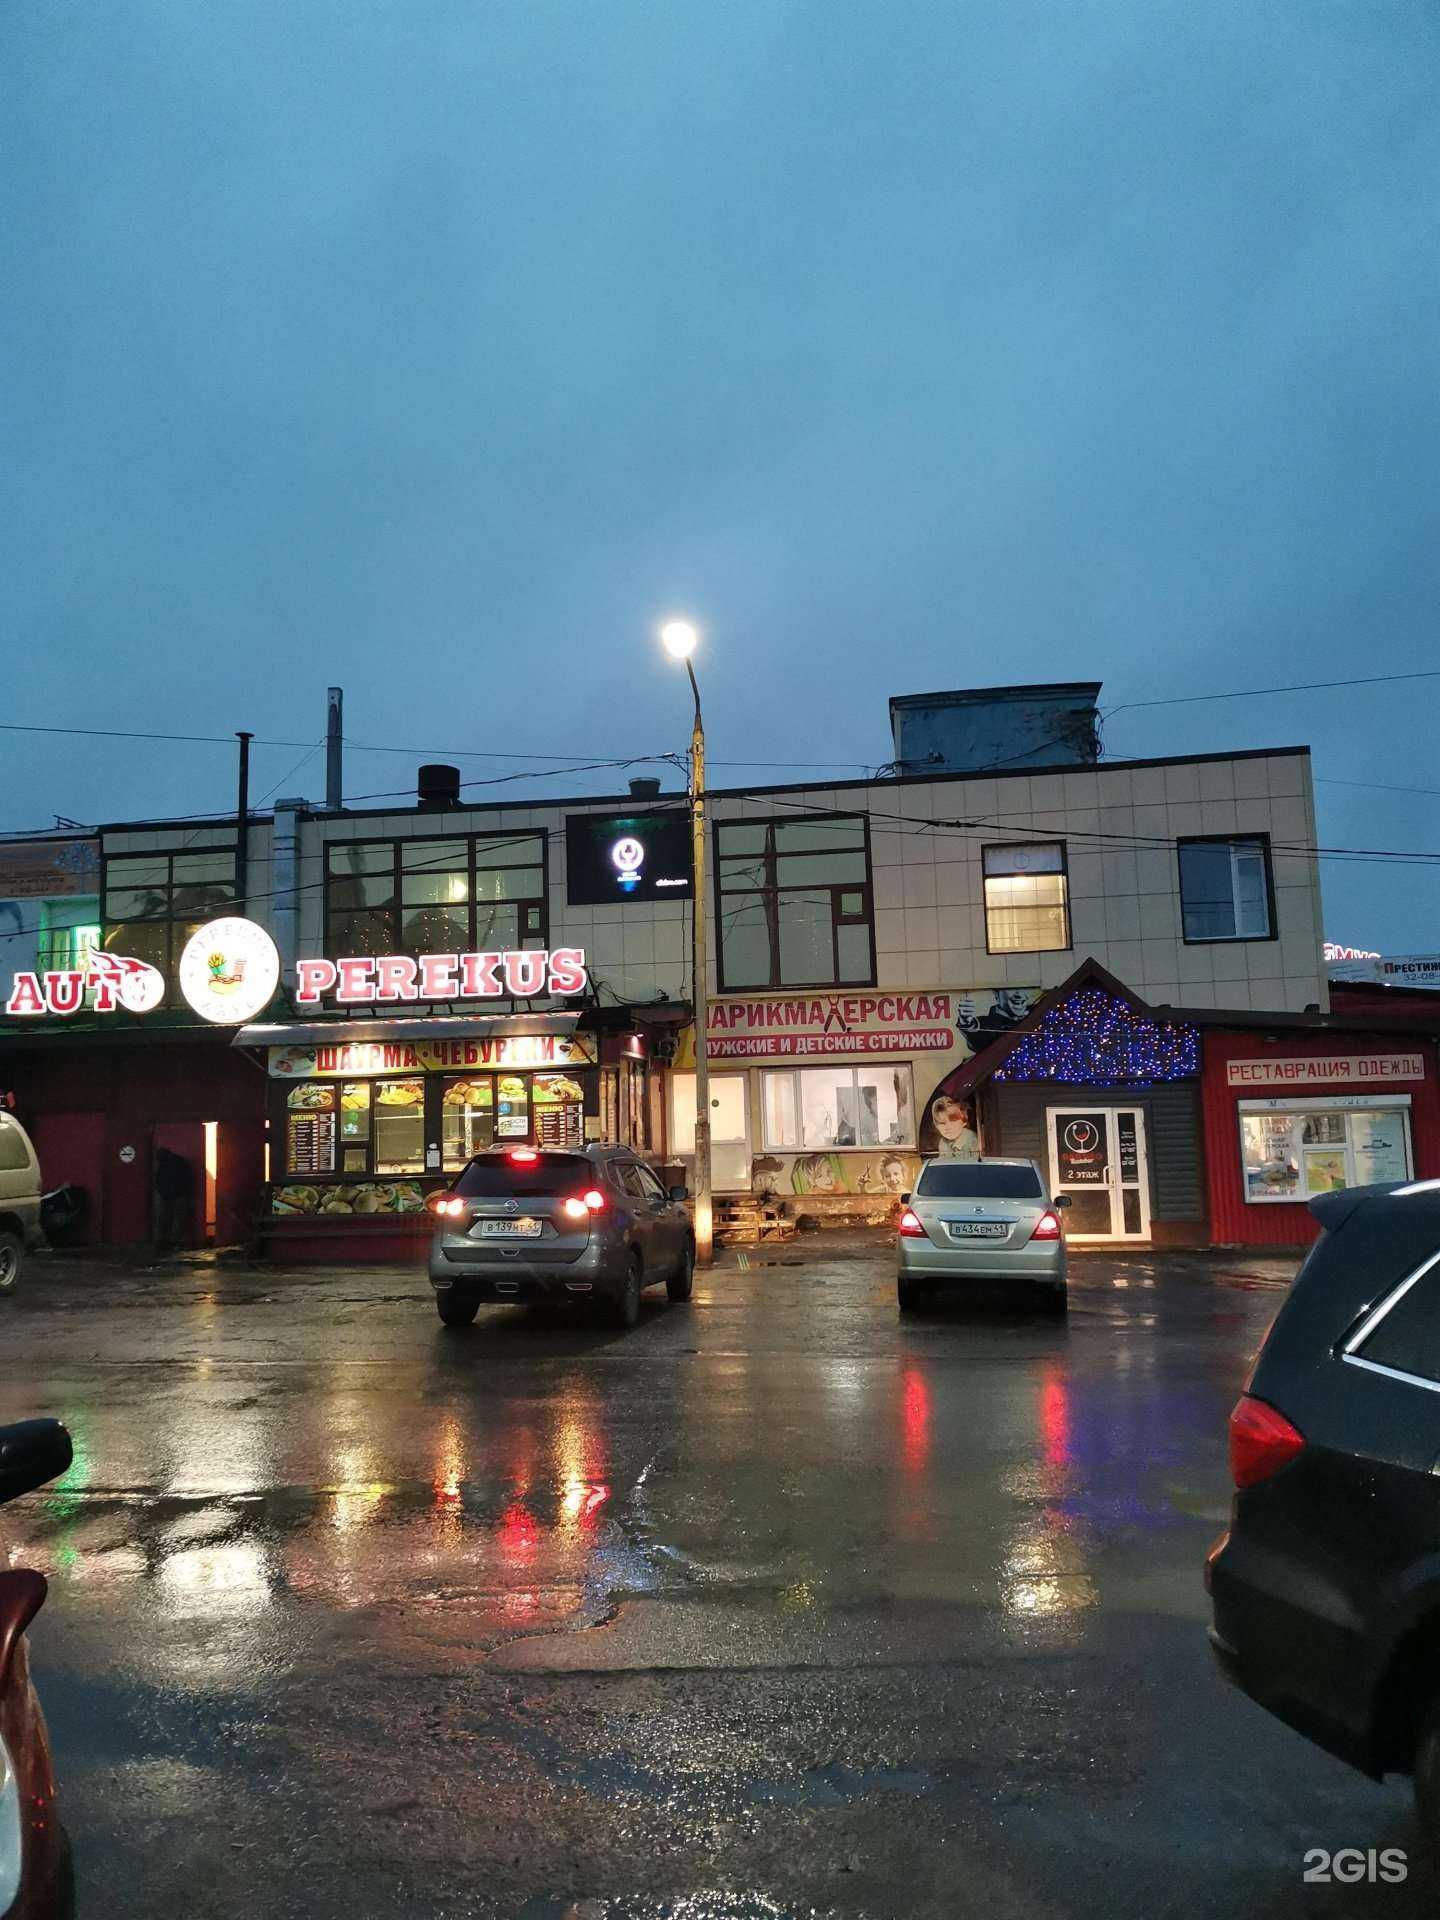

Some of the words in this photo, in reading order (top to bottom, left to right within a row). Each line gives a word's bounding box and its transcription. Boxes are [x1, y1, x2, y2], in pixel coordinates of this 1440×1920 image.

[6, 965, 165, 1014] AUTO
[296, 949, 588, 1003] PEREKUS
[706, 994, 951, 1031] АРИКМАХЕРСКАЯ
[780, 1038, 791, 1052] И
[796, 1035, 864, 1053] ДЕТСКИЕ
[869, 1032, 948, 1049] СТРИЖКИ
[1229, 1062, 1350, 1081] РЕСТАВРАЦИЯ
[1358, 1059, 1423, 1077] ОДЕЖДЫ
[1068, 1170, 1074, 1178] 2
